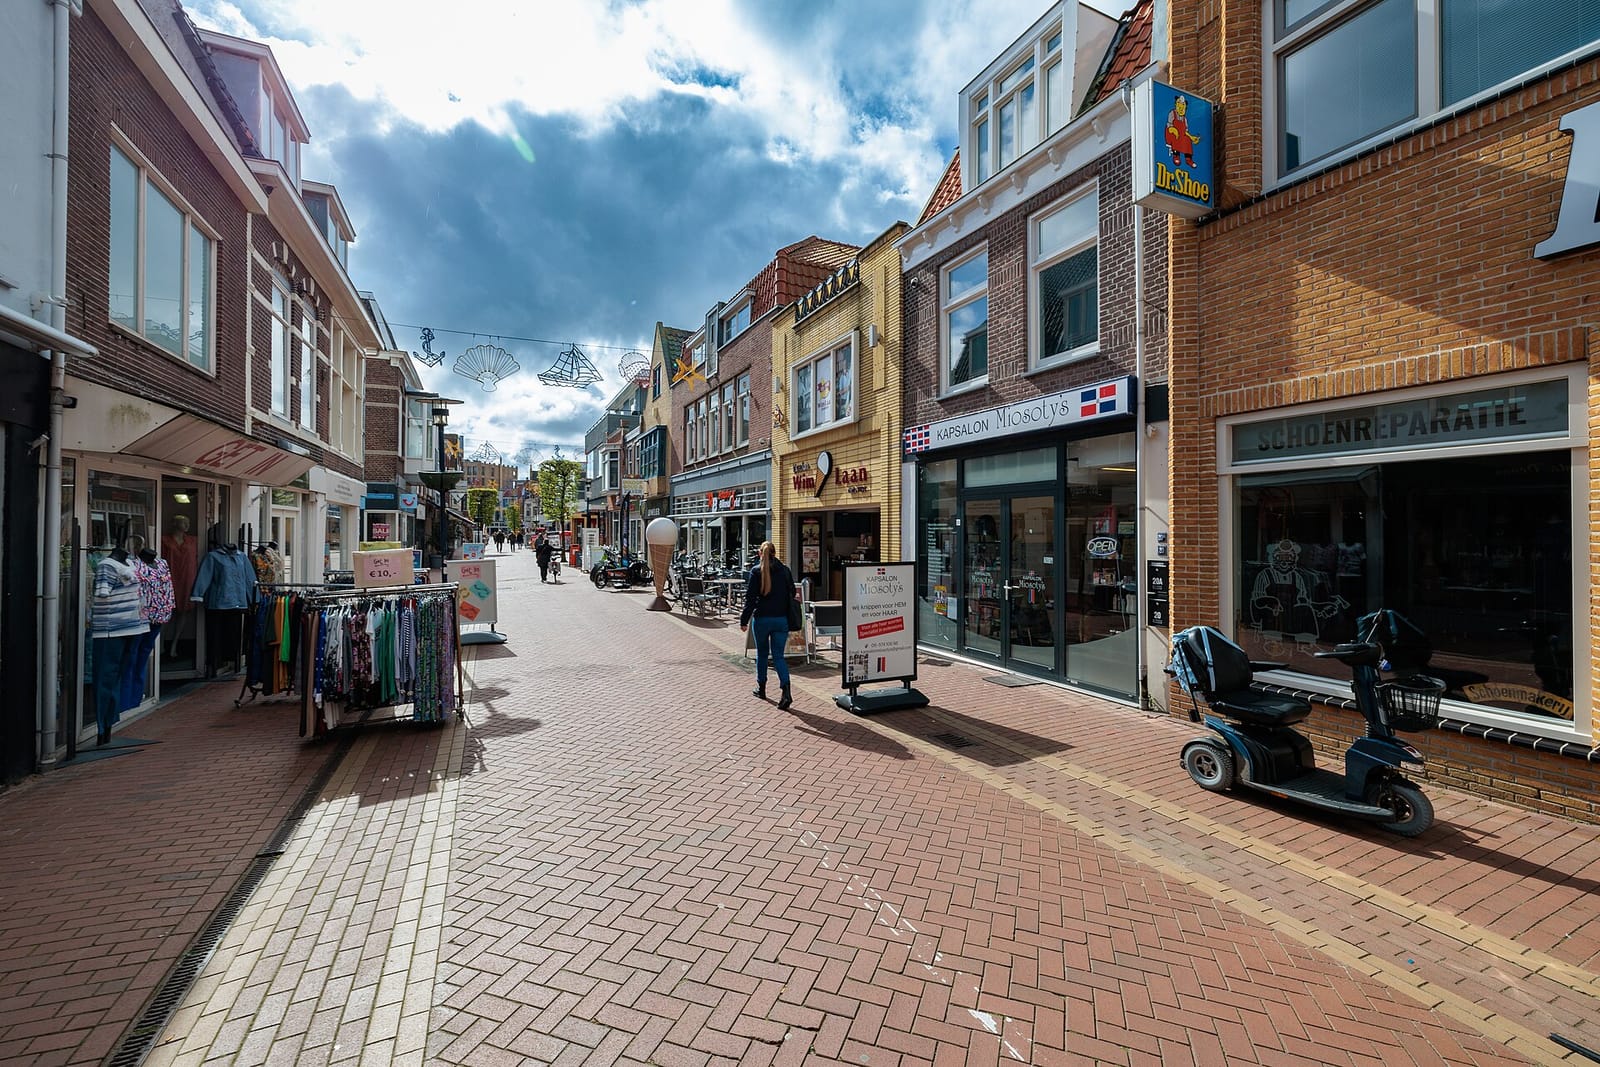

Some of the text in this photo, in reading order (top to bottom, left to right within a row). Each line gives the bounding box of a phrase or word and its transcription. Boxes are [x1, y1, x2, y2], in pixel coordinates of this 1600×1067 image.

[1156, 162, 1209, 201] Dr.Shoe
[936, 418, 989, 441] KAPSALON
[1257, 398, 1527, 451] SCHOENREPARATIE
[194, 438, 289, 477] GET IN
[793, 467, 868, 491] Wim Laan
[1087, 540, 1117, 552] OPEN
[1468, 685, 1571, 716] Schoenmakerij
